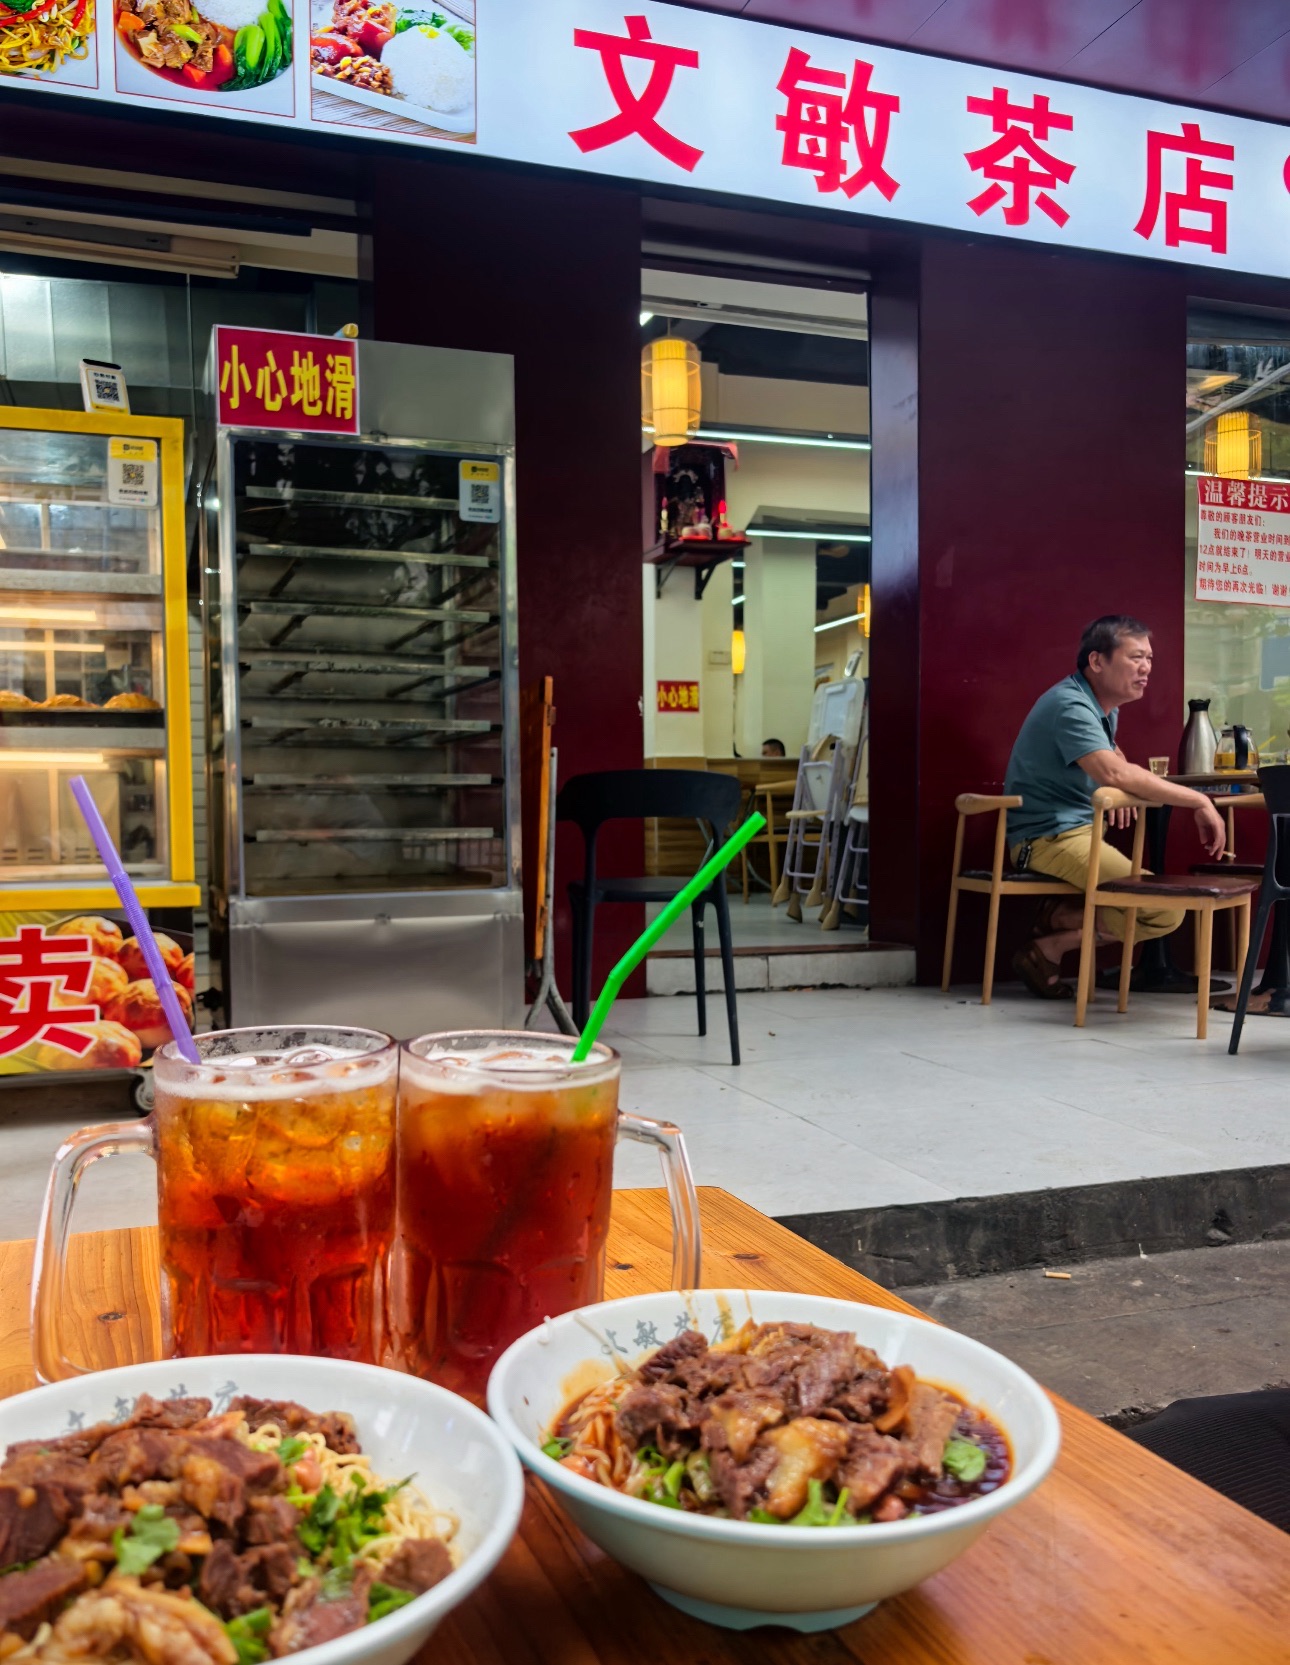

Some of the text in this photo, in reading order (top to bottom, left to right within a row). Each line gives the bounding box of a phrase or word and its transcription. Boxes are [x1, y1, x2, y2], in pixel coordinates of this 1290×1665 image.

[567, 15, 1235, 254] 文敏茶店
[219, 344, 356, 420] 小心地滑
[1204, 479, 1288, 511] 温馨提示
[0, 925, 100, 1058] 卖
